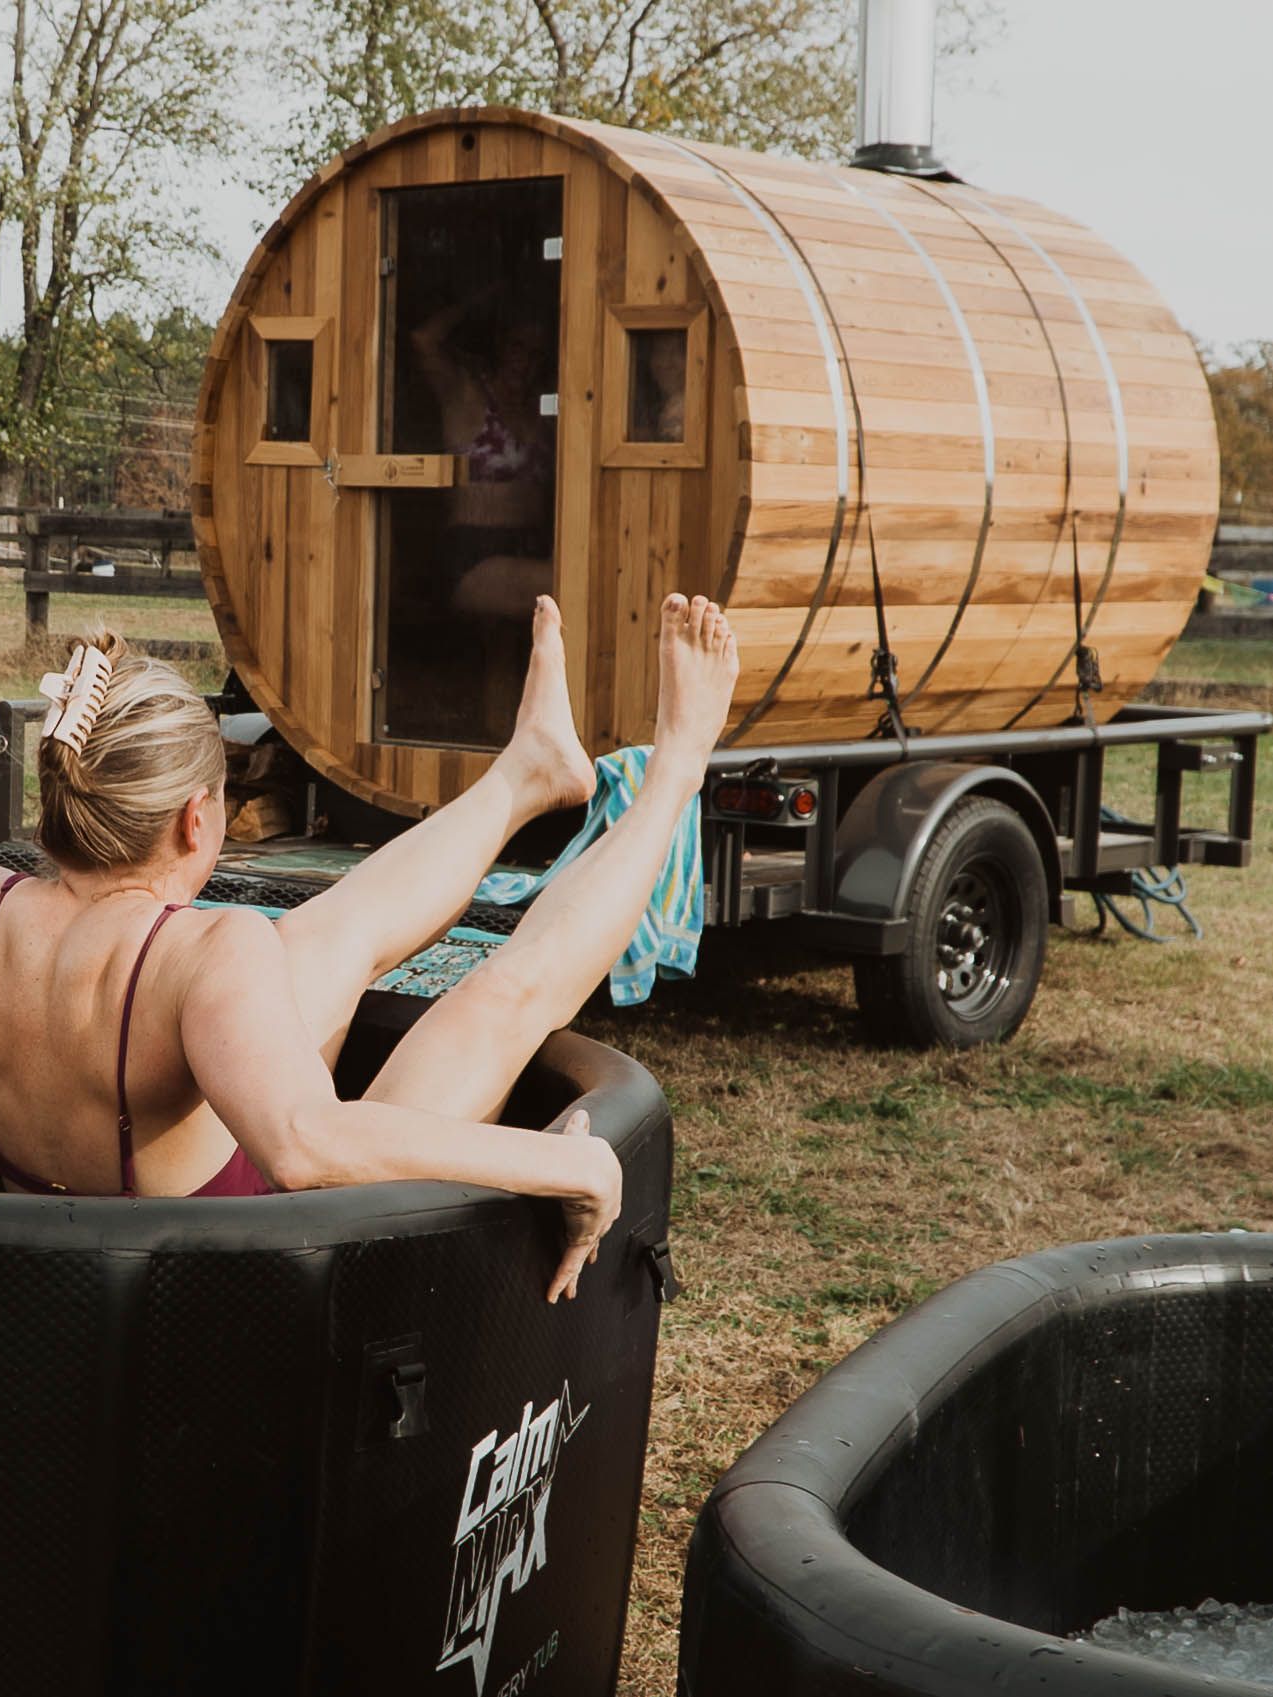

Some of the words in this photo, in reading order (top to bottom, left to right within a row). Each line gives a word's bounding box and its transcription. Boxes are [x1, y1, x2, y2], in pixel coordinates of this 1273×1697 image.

[452, 1400, 560, 1545] Calm
[497, 1660, 531, 1697] ERY
[533, 1629, 559, 1677] TUB
